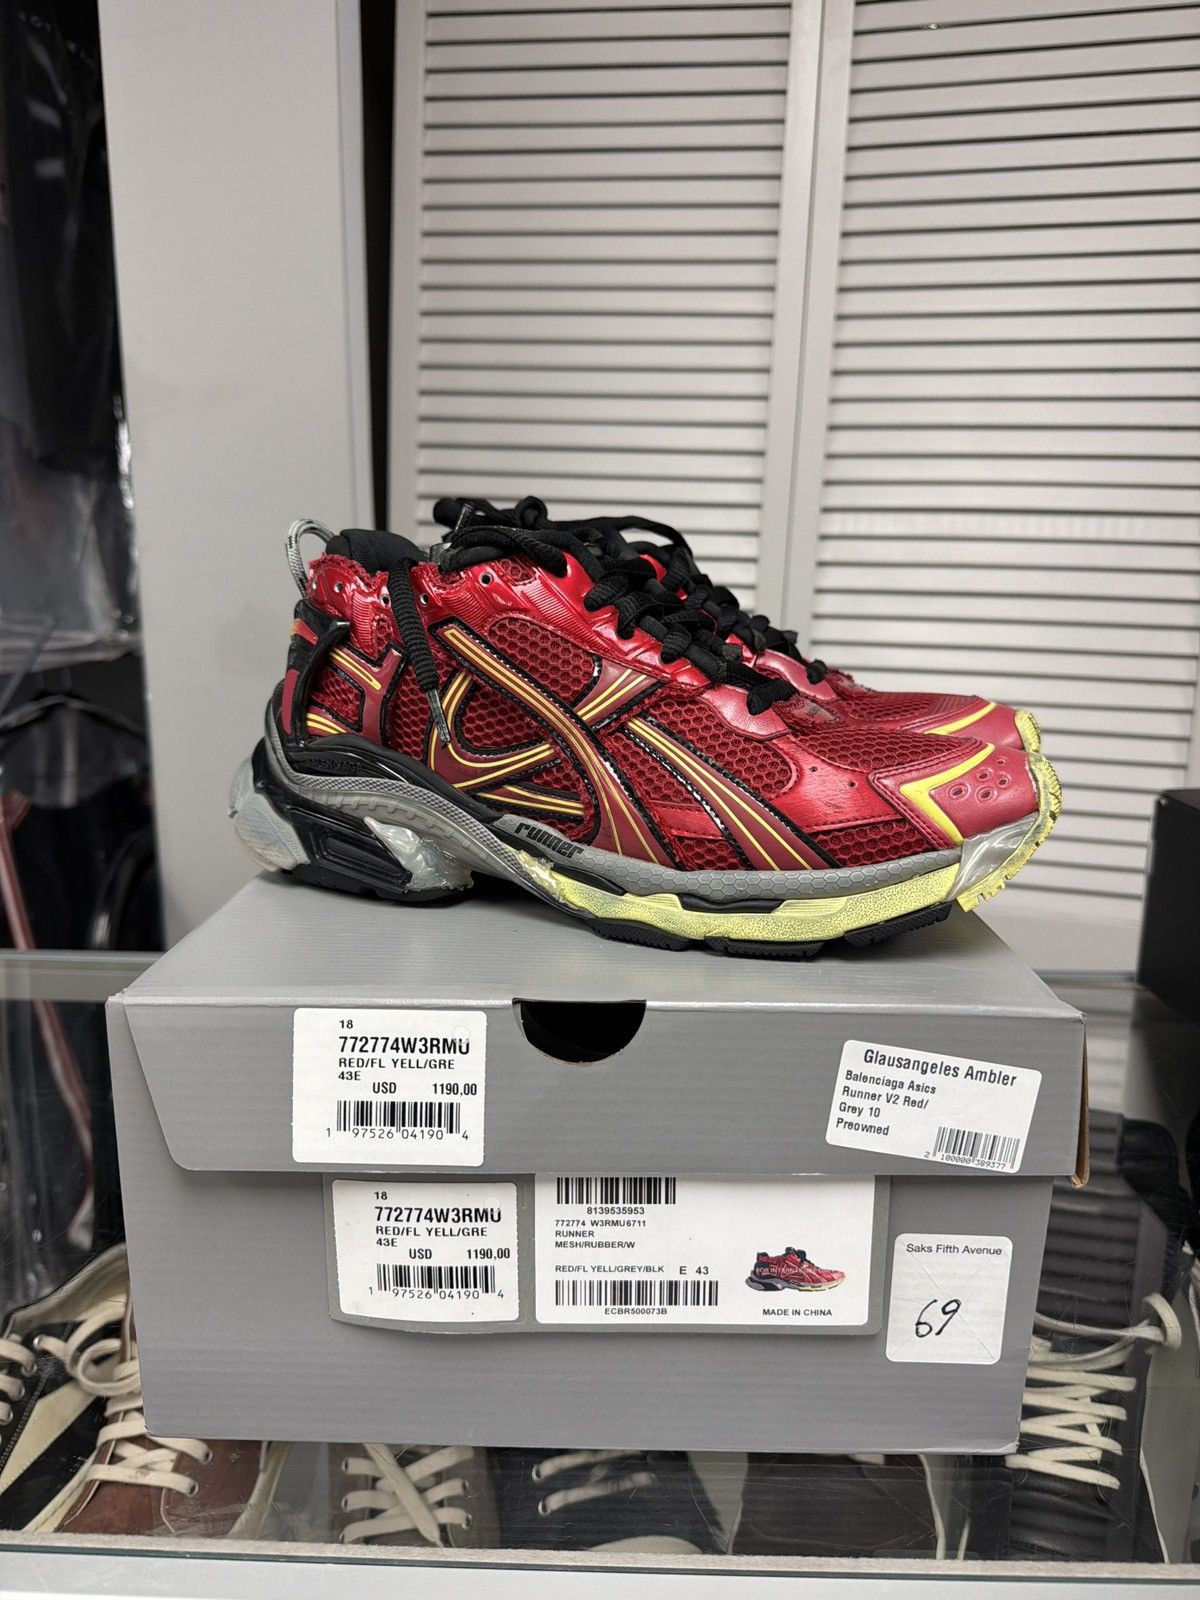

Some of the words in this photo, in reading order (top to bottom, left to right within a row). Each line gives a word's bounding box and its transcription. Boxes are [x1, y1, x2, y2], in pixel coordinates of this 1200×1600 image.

[514, 822, 584, 859] runner
[339, 1019, 354, 1029] 18
[338, 1036, 470, 1055] 772774W3RMU
[338, 1057, 386, 1068] RED/FL
[391, 1058, 455, 1070] YELL/GRE
[863, 1048, 960, 1078] Glausangeles
[963, 1065, 1017, 1087] Ambler
[338, 1071, 361, 1081] 43E
[844, 1070, 905, 1090] Balenciaga
[907, 1081, 937, 1095] Asics
[372, 1082, 397, 1094] USD
[432, 1083, 477, 1096] 1190,00
[842, 1086, 882, 1102] Runner
[886, 1093, 899, 1105] V2
[902, 1096, 929, 1109] Red/
[839, 1101, 864, 1116] Grey
[868, 1106, 881, 1118] 10
[836, 1117, 890, 1136] Preowned
[351, 1128, 394, 1139] 97526
[401, 1129, 443, 1140] 04190
[461, 1130, 469, 1140] 4
[374, 1191, 388, 1200] 18
[374, 1206, 502, 1223] 772774W3RMU
[587, 1207, 645, 1215] 8139535953
[376, 1226, 421, 1236] RED/FL
[426, 1227, 488, 1237] YELL/GRE
[555, 1230, 595, 1238] RUNNER
[376, 1238, 398, 1247] 43E
[555, 1241, 636, 1249] MESH/RUBBER/W
[409, 1249, 432, 1259] USD
[467, 1248, 511, 1261] 1190,00
[906, 1243, 932, 1253] Saks
[936, 1244, 959, 1254] Fifth
[962, 1246, 1003, 1256] Avenue
[555, 1265, 588, 1273] RED/FL
[590, 1265, 665, 1273] YELL/GREY/BLK
[679, 1266, 687, 1275] E
[695, 1266, 709, 1275] 43
[392, 1288, 432, 1299] 97526
[439, 1290, 480, 1299] 04190
[497, 1290, 504, 1298] 4
[604, 1307, 668, 1315] ECBR500073B
[762, 1308, 789, 1316] MADE
[792, 1308, 801, 1316] IN
[803, 1308, 832, 1316] CHINA
[914, 1298, 961, 1338] 69
